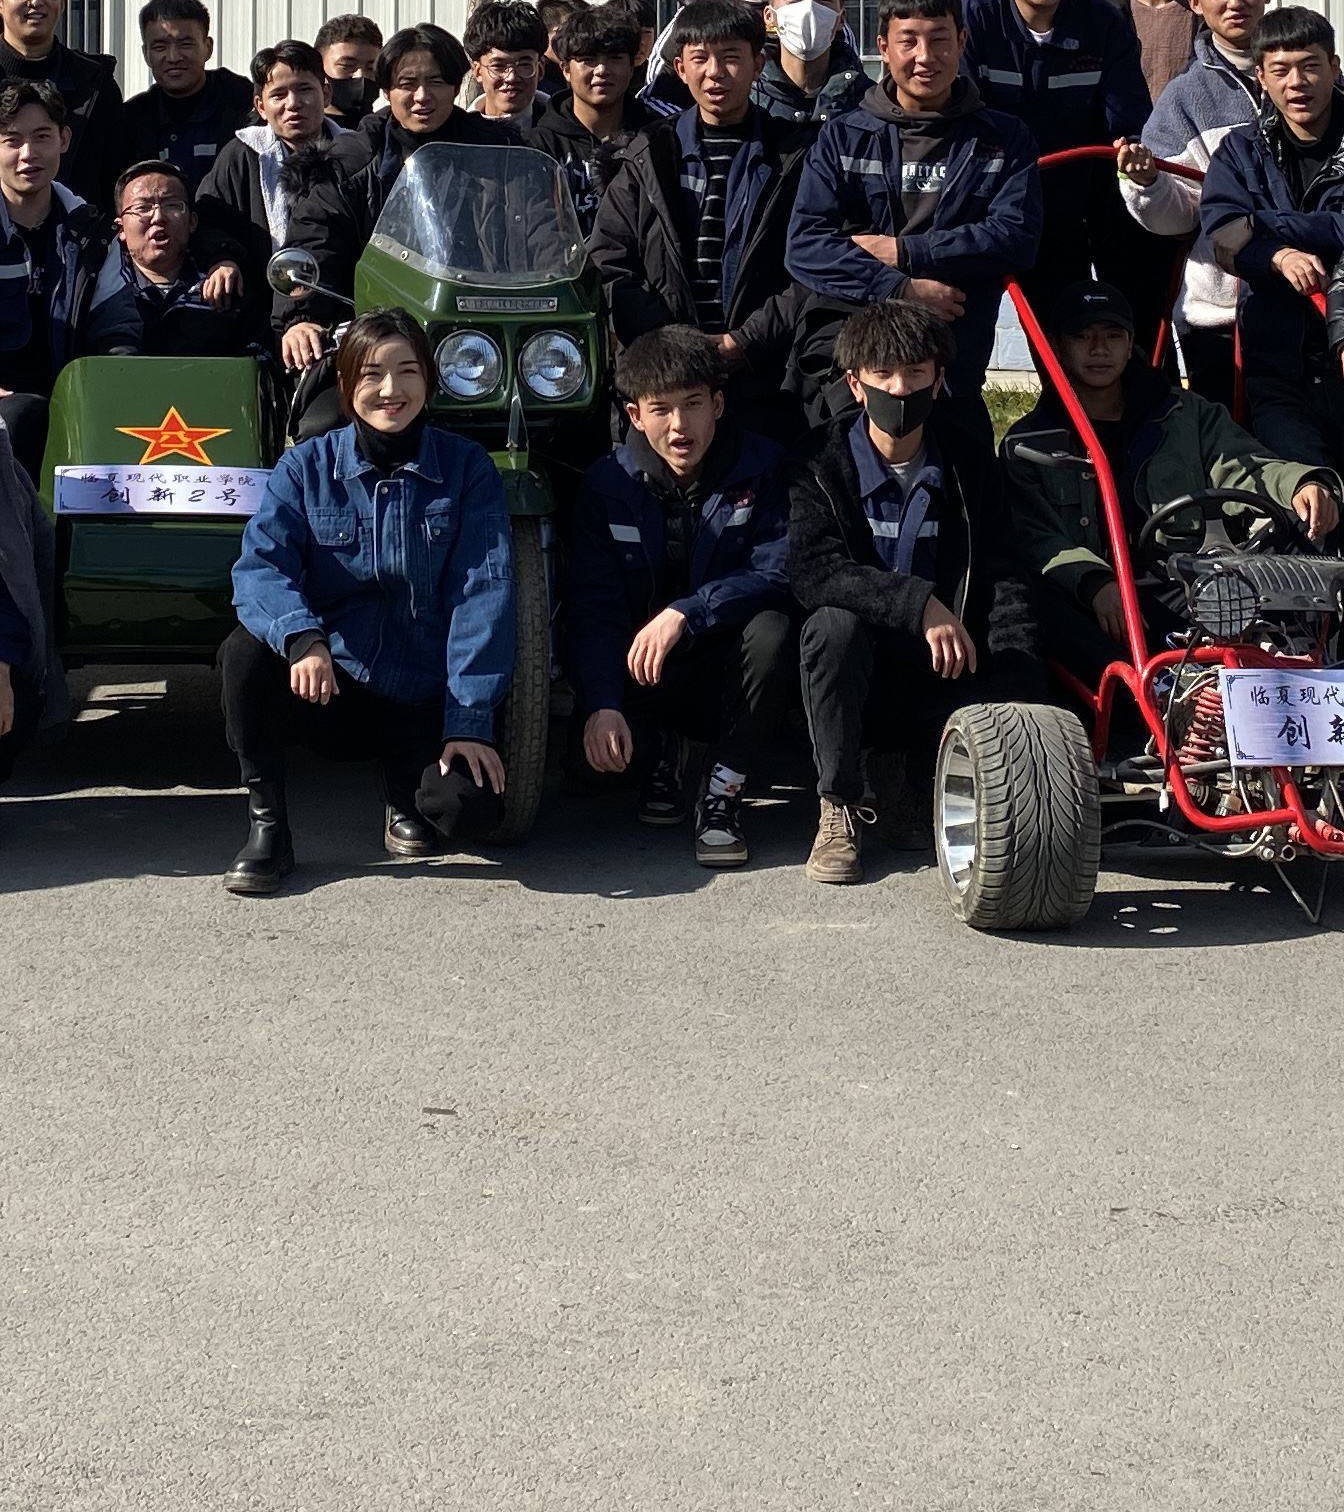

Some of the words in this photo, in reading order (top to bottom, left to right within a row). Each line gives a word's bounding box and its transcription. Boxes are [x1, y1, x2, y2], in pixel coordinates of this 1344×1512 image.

[80, 472, 256, 487] 临夏现代职业学院
[100, 486, 242, 506] 创新2号
